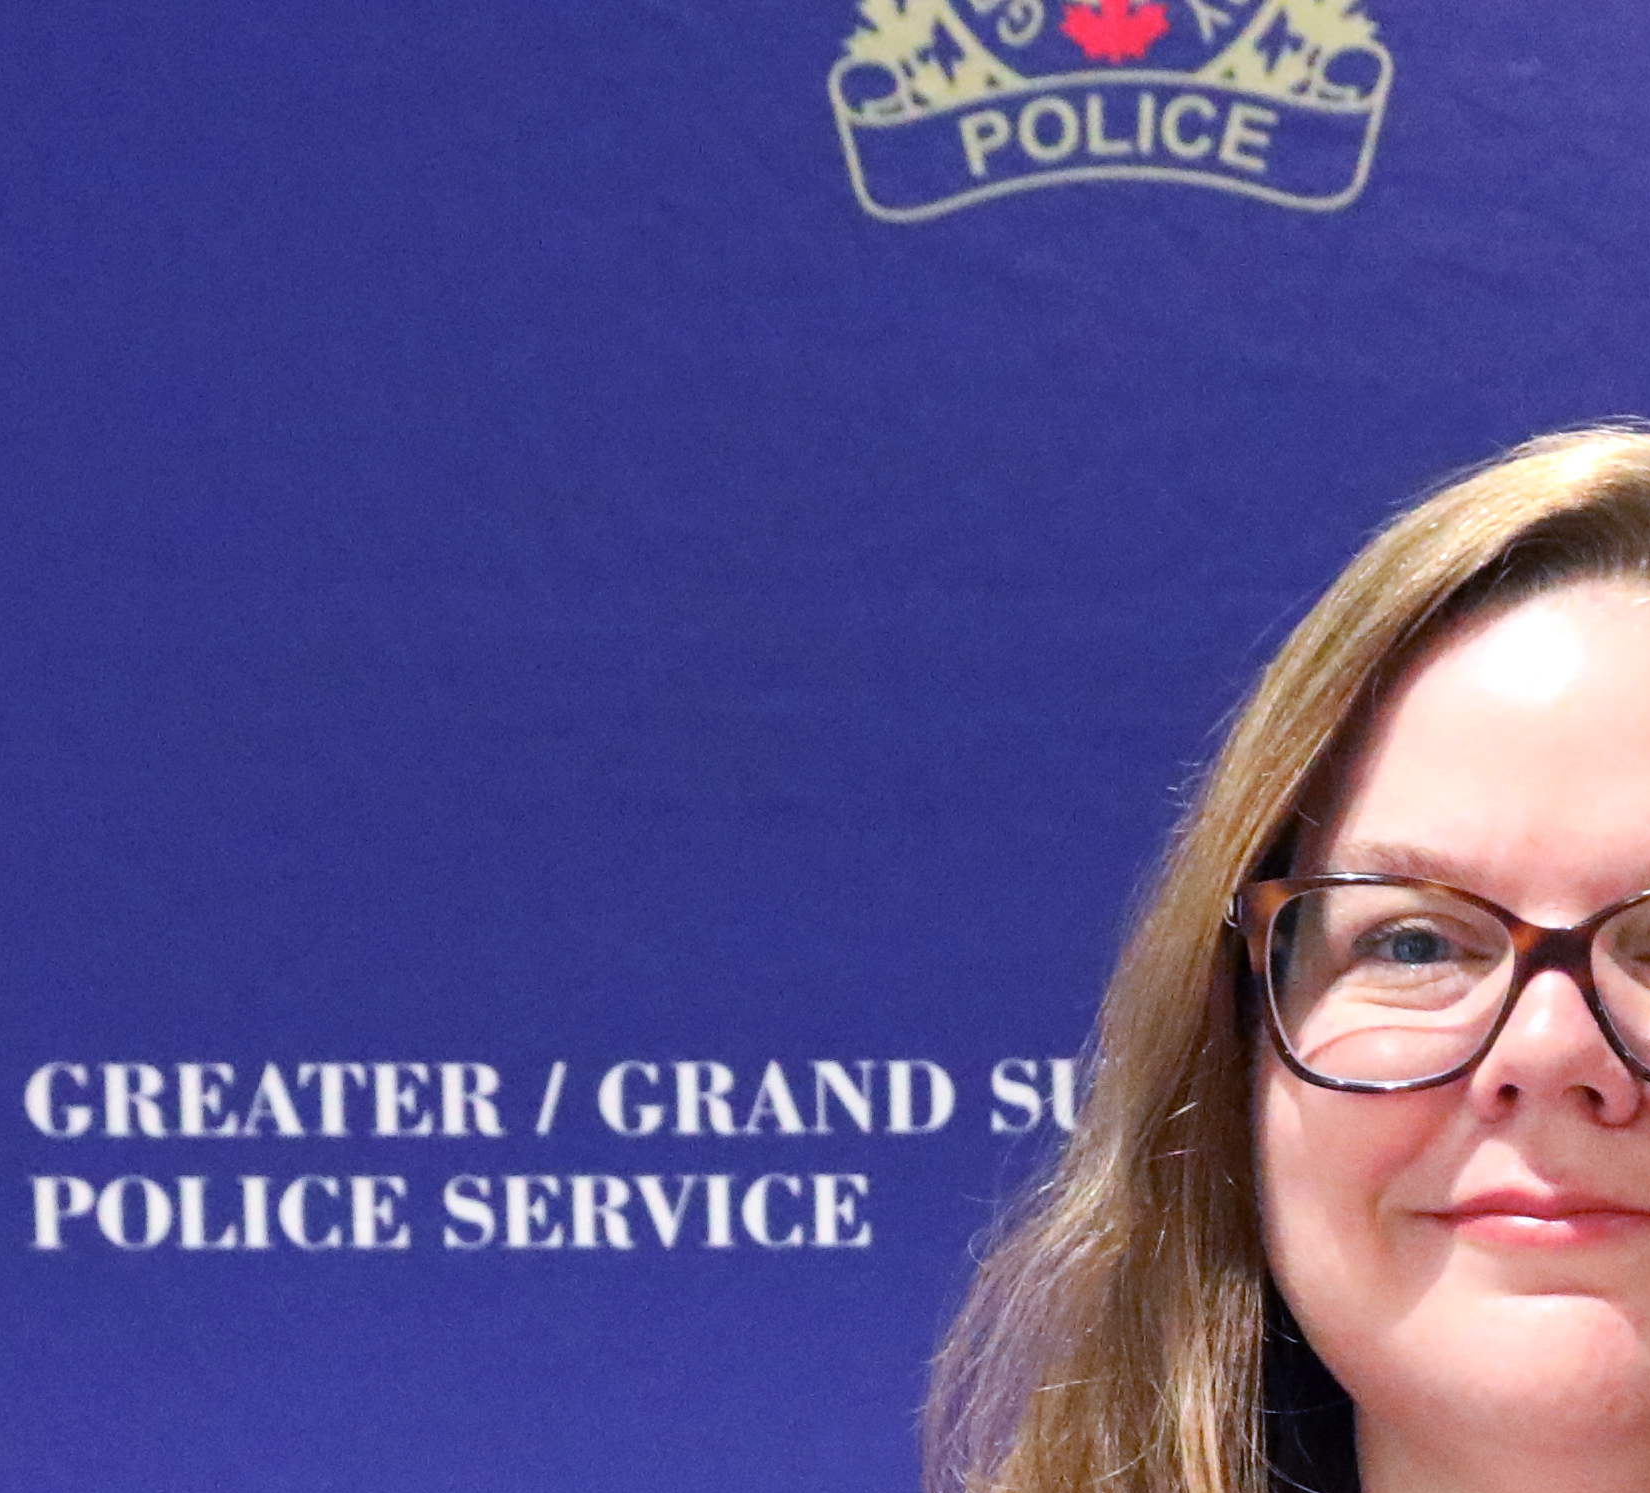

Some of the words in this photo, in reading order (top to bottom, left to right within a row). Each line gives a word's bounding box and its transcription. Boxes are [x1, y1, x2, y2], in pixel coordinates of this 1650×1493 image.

[959, 94, 1279, 178] POLICE
[25, 1062, 503, 1138] GREATER
[535, 1061, 567, 1136] /
[598, 1060, 955, 1136] GRAND
[34, 1176, 410, 1250] POLICE
[444, 1174, 871, 1249] SERVICE
